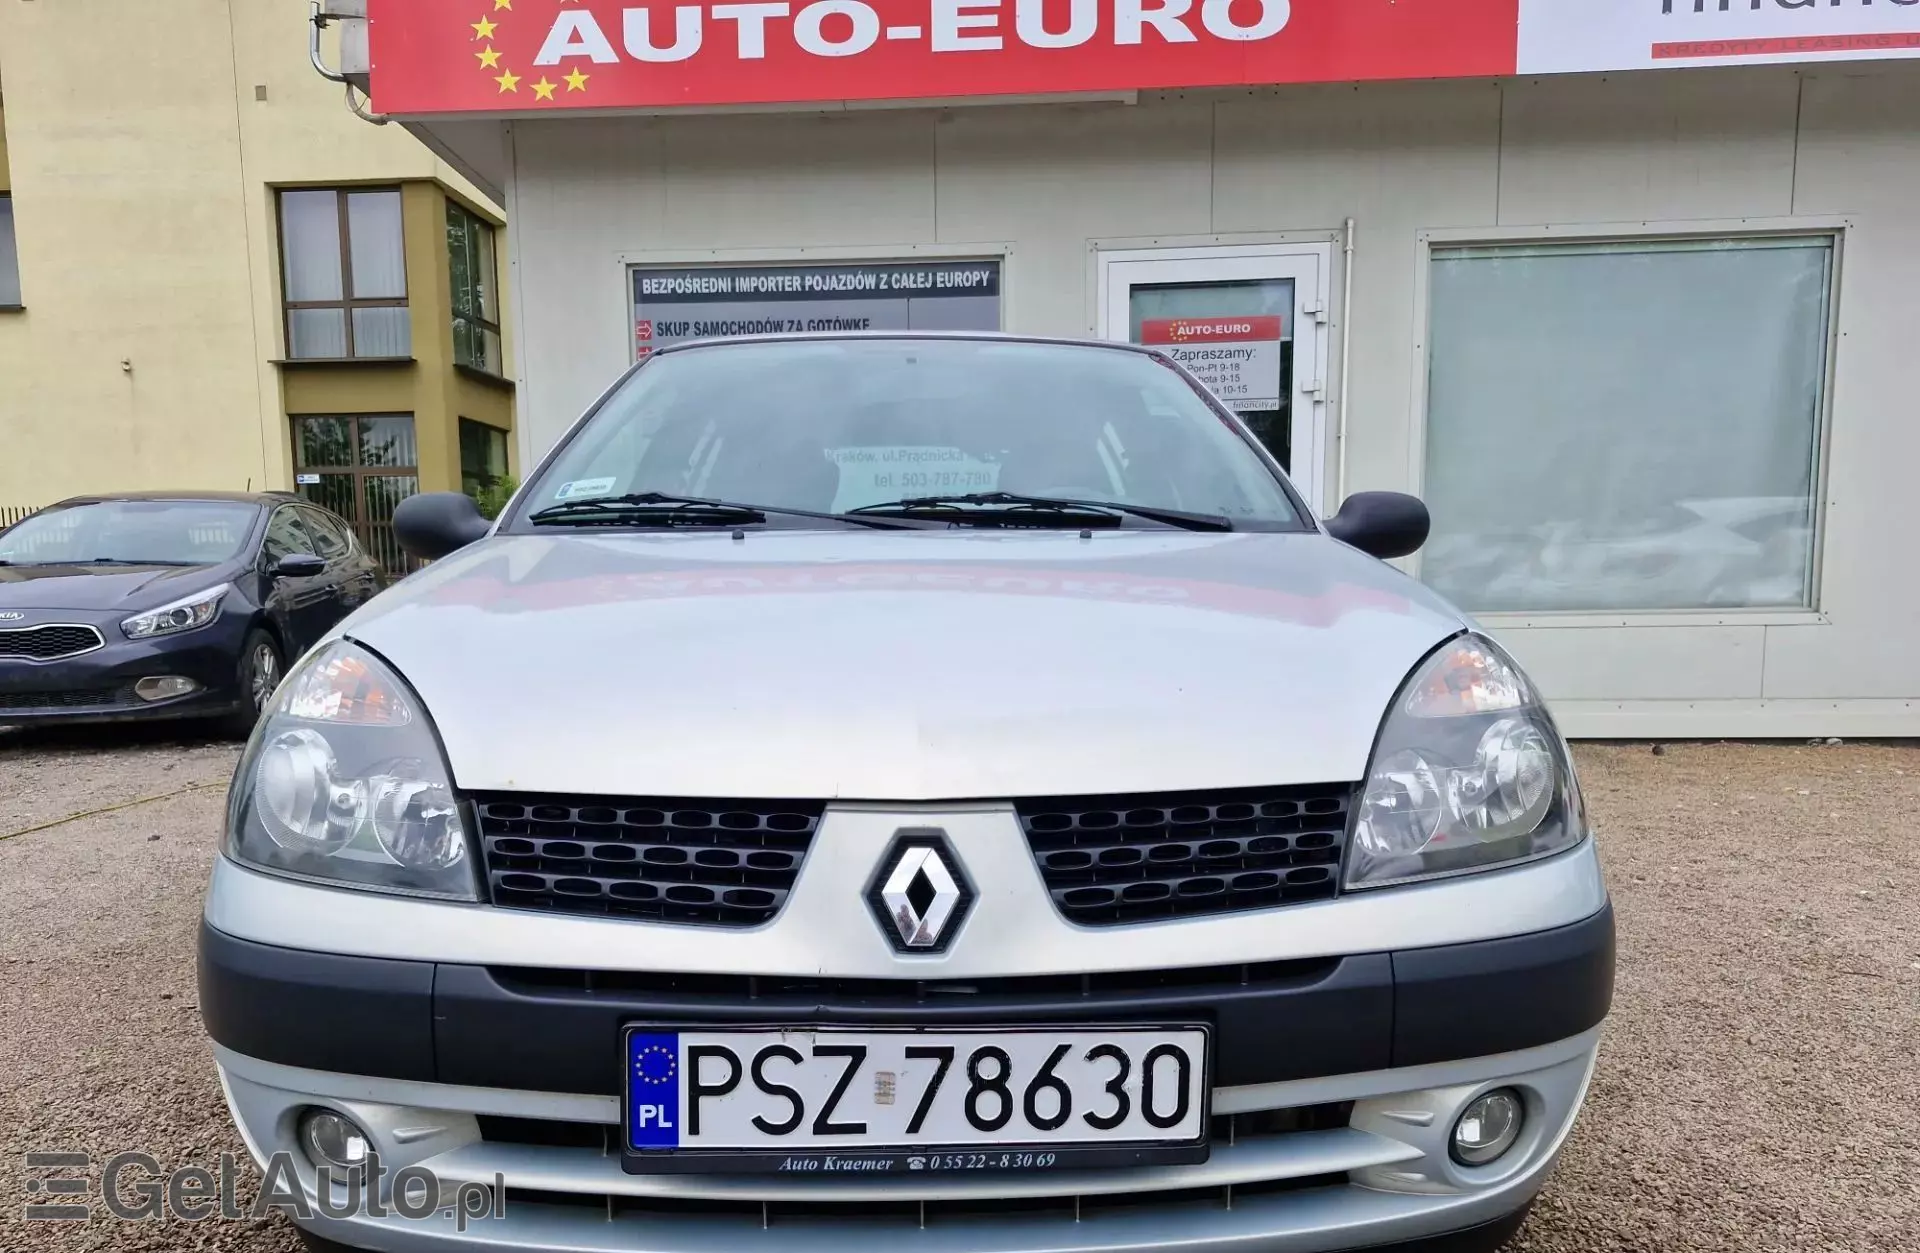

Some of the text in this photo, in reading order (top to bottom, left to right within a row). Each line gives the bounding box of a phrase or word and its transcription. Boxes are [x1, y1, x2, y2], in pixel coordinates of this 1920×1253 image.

[533, 0, 1291, 66] AUTO-EURO
[642, 270, 990, 295] BEZPOŚREDNI IMPORTER POJAZDÓW Z CAŁEJ EUROPY
[656, 320, 690, 337] SKUP
[694, 316, 784, 336] SAMOCHODÓW
[787, 319, 804, 332] ZA
[1177, 323, 1251, 335] AUTO-EURO
[1171, 348, 1257, 362] Zapraszamy:
[1187, 362, 1241, 373] Pon-Pt 9-18
[1219, 374, 1241, 383] 9-15
[1223, 384, 1248, 394] 10-15
[688, 1044, 1190, 1135] PSZ 78630
[639, 1104, 672, 1128] PL
[778, 1157, 818, 1170] Auto
[823, 1157, 894, 1170] Kraemer
